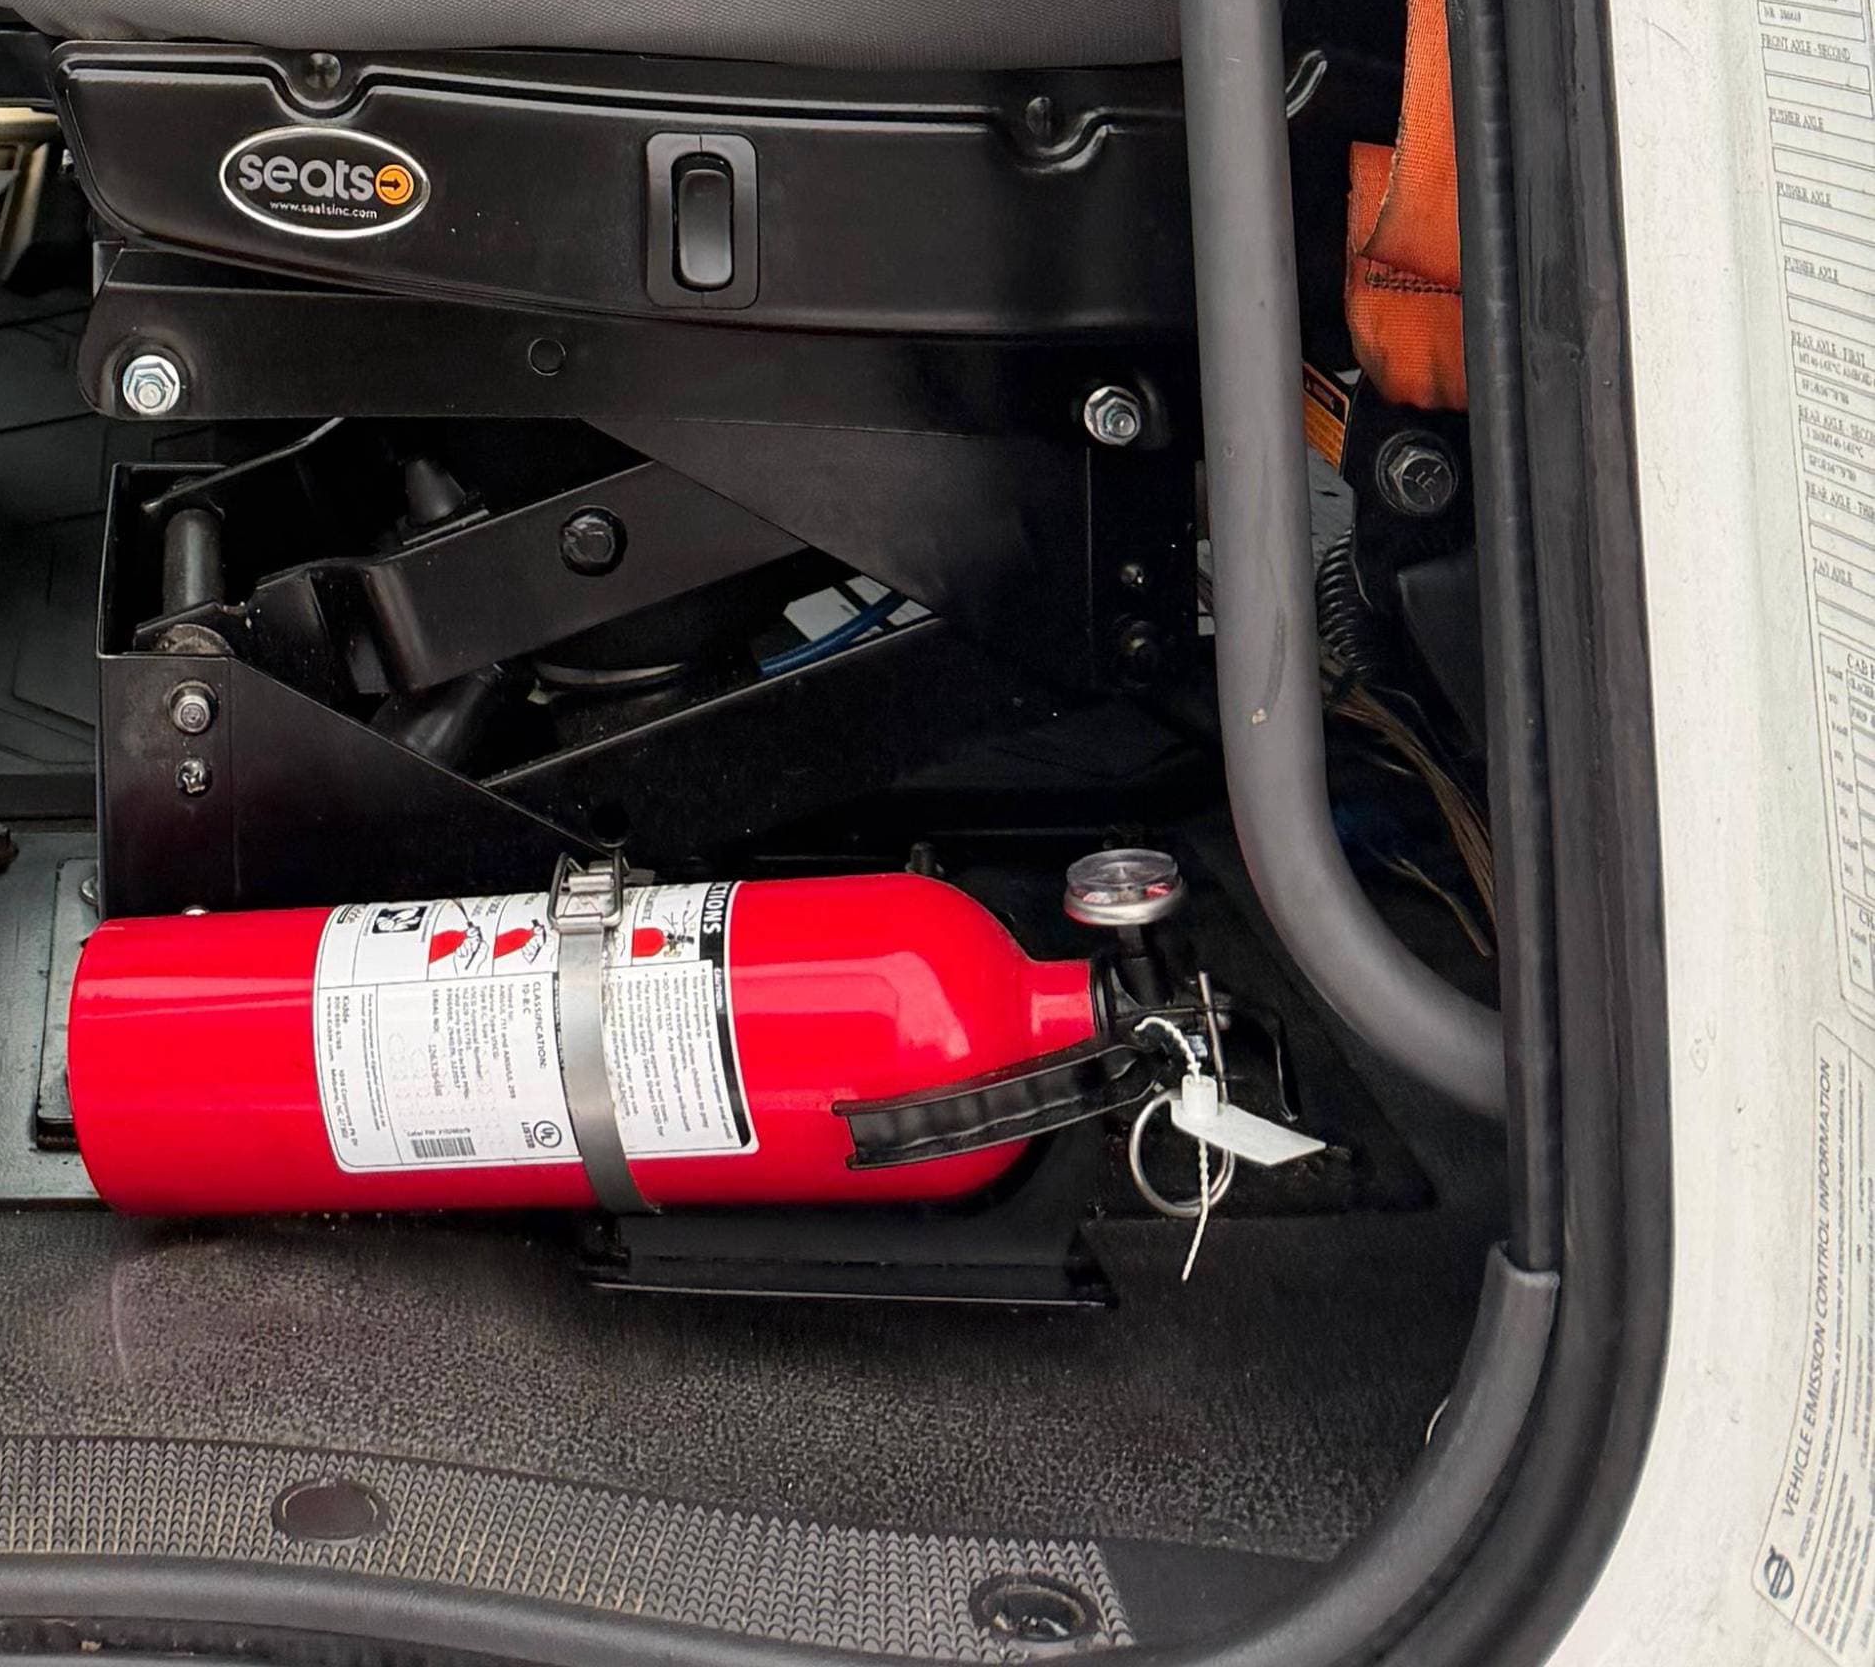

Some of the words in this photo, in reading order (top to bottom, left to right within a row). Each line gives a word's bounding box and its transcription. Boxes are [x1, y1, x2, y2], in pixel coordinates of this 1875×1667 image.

[1790, 38, 1811, 54] AXLE
[238, 154, 375, 201] seats
[532, 981, 547, 1069] CLASSIFICATION:
[1818, 1057, 1832, 1224] INFORMATION
[1817, 1227, 1830, 1320] CONTROL
[1804, 1326, 1826, 1430] EMISSION
[1781, 1432, 1810, 1520] VEHICLE
